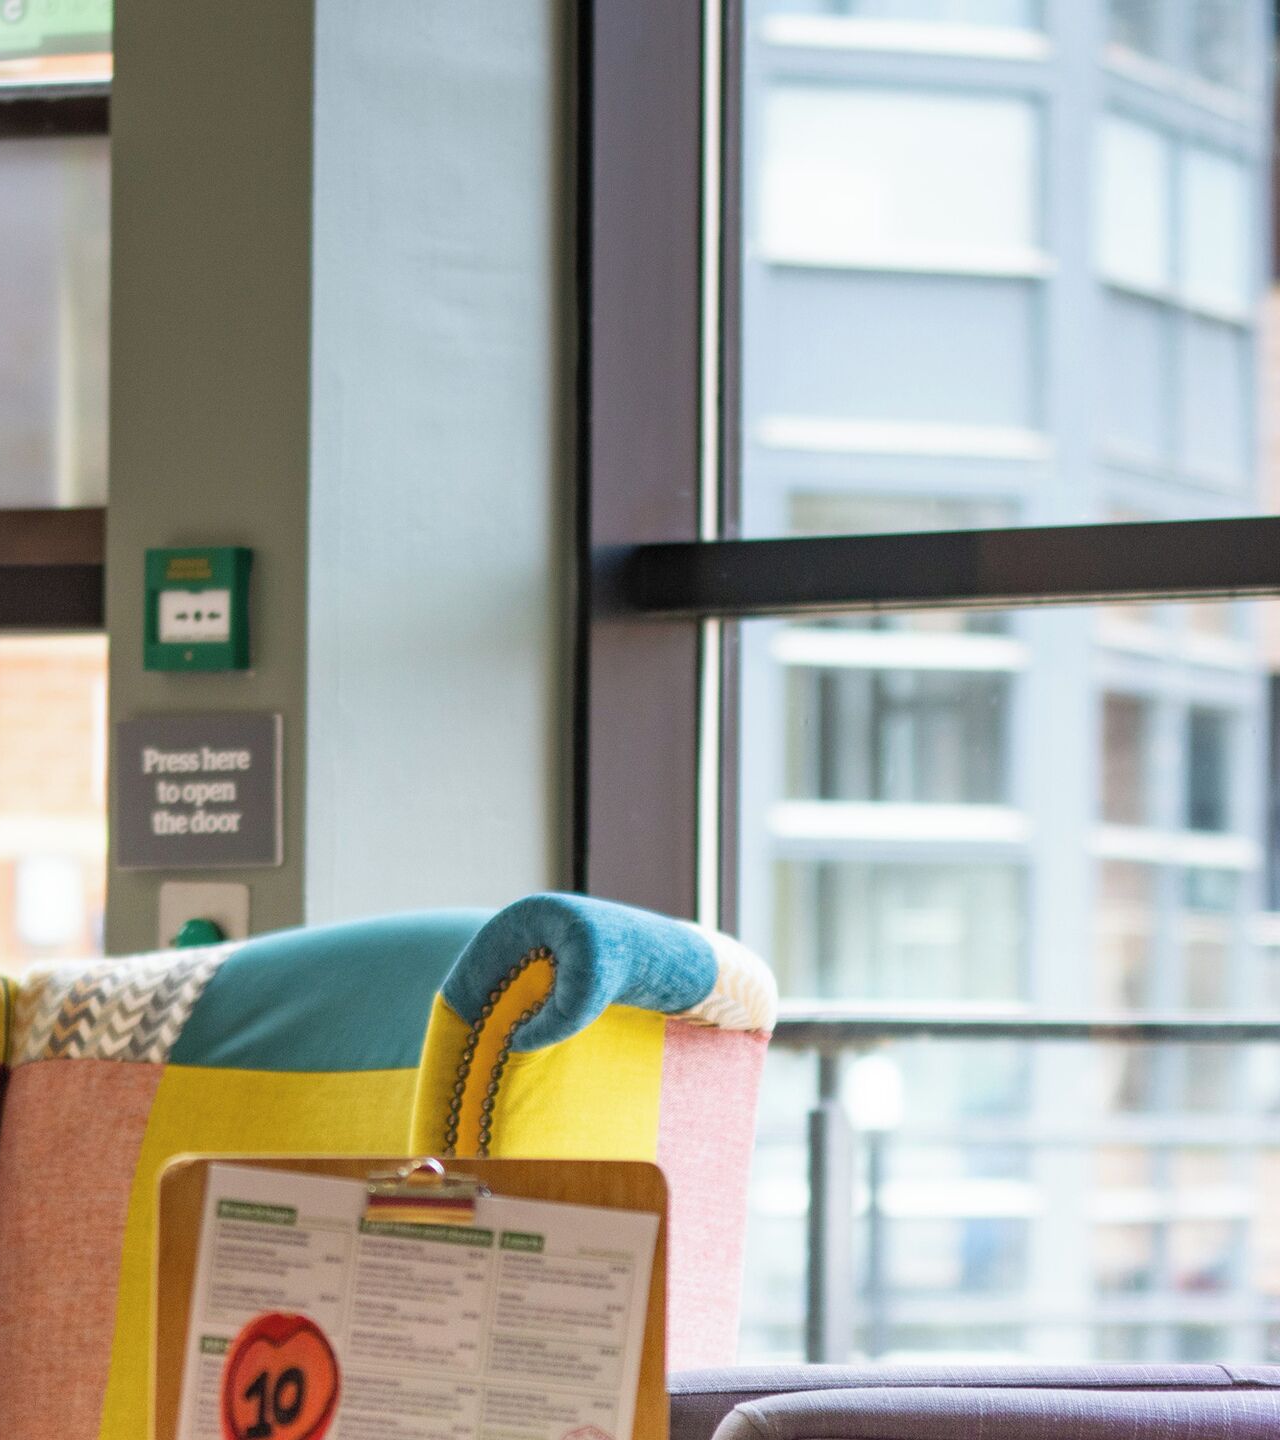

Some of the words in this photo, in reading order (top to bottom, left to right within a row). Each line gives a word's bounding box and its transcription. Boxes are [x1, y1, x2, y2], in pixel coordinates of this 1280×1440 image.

[142, 747, 200, 774] Press
[201, 746, 251, 771] here
[157, 781, 181, 804] to
[182, 781, 236, 807] open
[152, 810, 189, 835] the
[190, 809, 242, 833] door
[244, 1366, 306, 1440] 10
